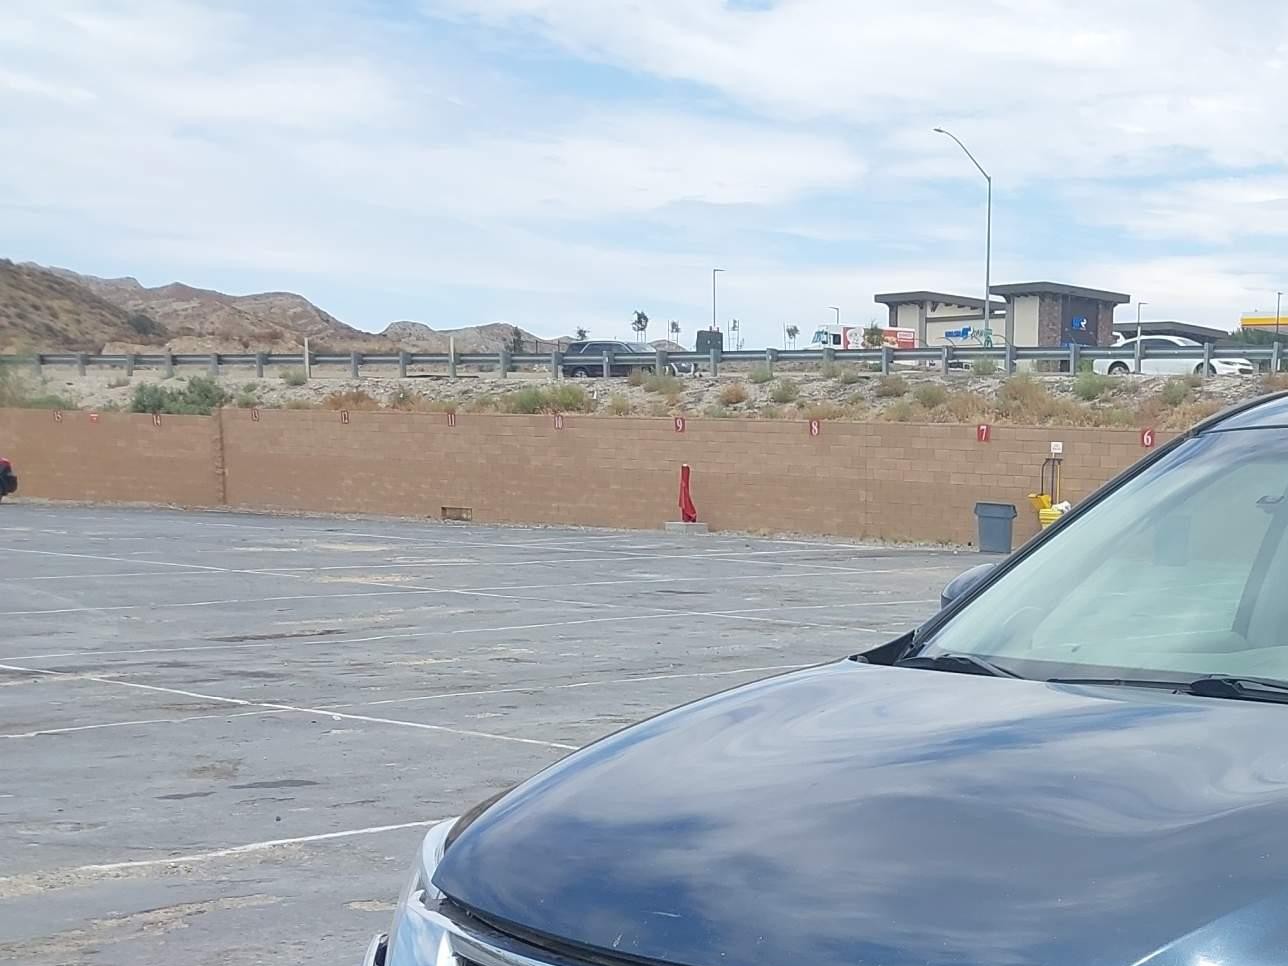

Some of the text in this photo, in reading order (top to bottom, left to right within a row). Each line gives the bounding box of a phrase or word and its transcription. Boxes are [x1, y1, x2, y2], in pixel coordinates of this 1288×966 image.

[676, 418, 683, 431] 9
[811, 420, 818, 435] 8
[979, 425, 987, 441] 7
[1143, 431, 1152, 447] 6
